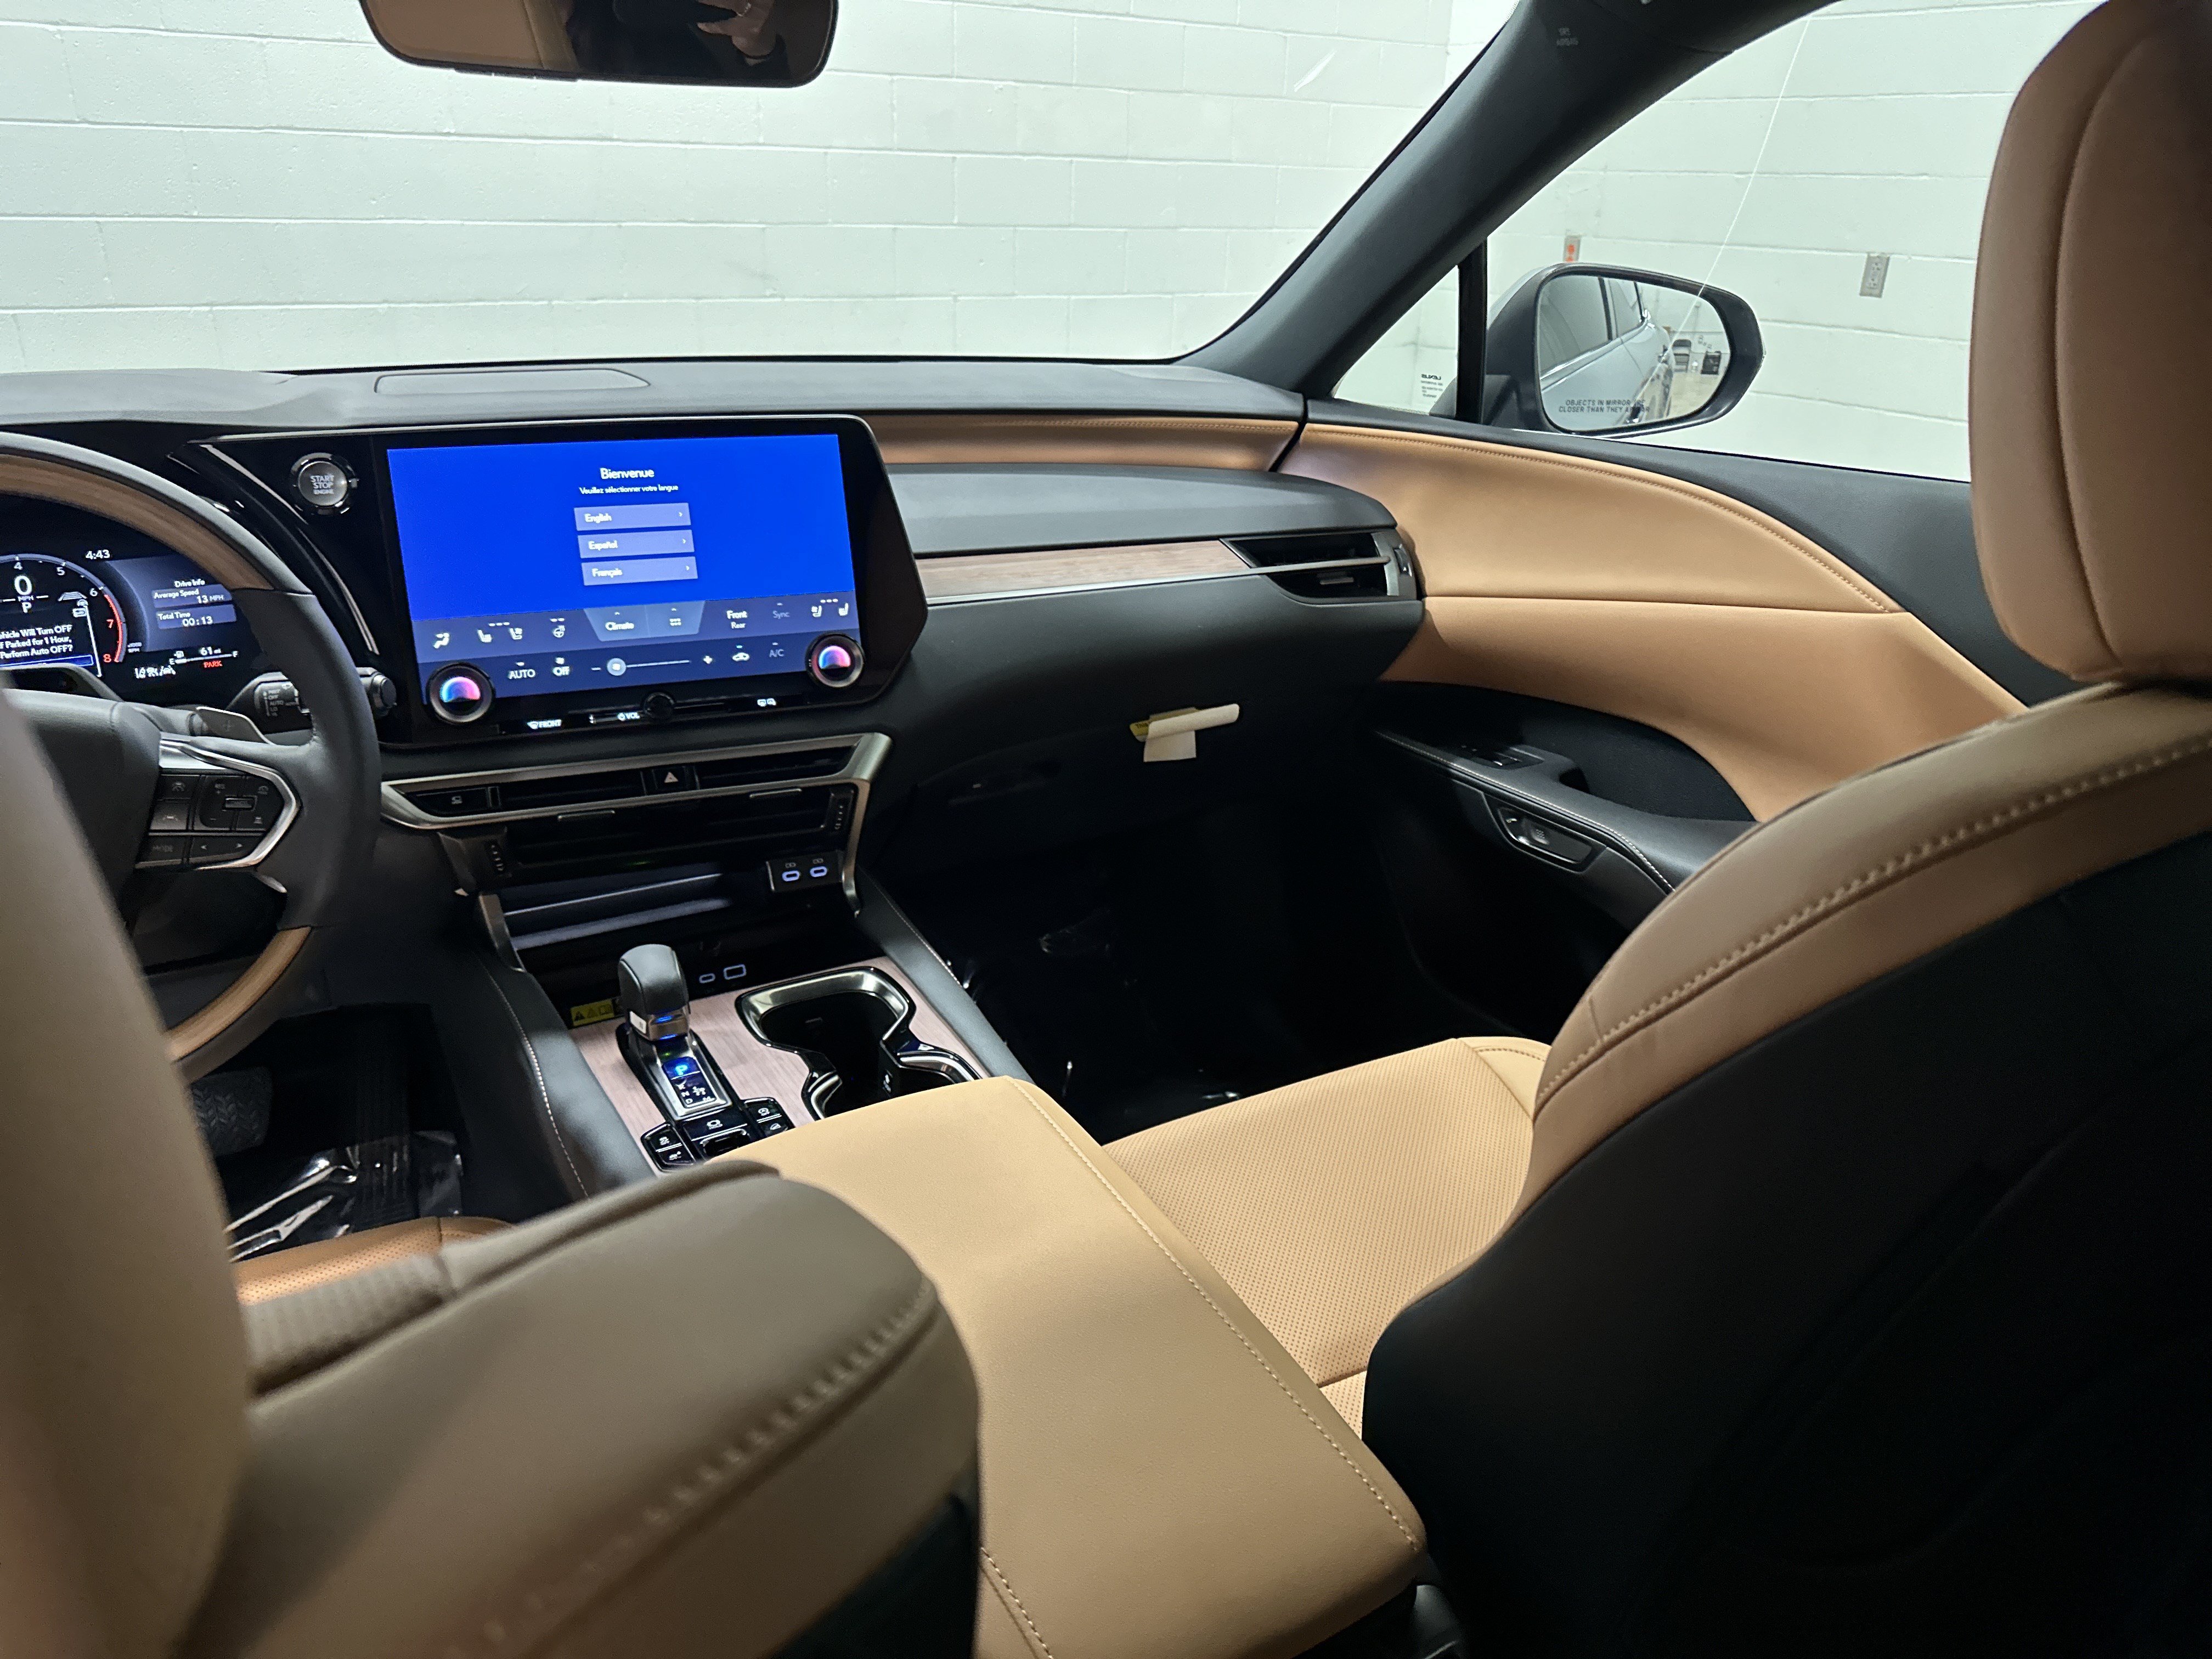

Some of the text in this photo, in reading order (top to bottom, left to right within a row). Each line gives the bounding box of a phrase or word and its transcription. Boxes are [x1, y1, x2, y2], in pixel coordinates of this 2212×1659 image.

[600, 467, 655, 479] Bienvenue
[309, 475, 335, 483] START
[658, 484, 679, 493] langue
[584, 513, 612, 524] English
[588, 540, 618, 551] Español
[85, 549, 111, 560] 4:43
[14, 562, 23, 571] 4
[57, 567, 66, 576] 5
[591, 568, 623, 578] Français
[14, 574, 33, 596] 0
[89, 588, 98, 597] 6
[154, 588, 200, 599] Average Speed
[196, 595, 208, 604] 13
[21, 601, 32, 613] P
[157, 612, 174, 620] Total
[726, 610, 748, 619] Front
[772, 610, 790, 619] Sync
[106, 619, 114, 629] 7
[605, 622, 635, 631] Climate
[731, 621, 747, 629] Rear
[0, 624, 72, 639] ehicle Will Turn OFF
[5, 639, 32, 648] Parked
[31, 637, 43, 646] for
[49, 635, 72, 644] Hour,
[0, 644, 74, 659] Perform Auto OFF?
[199, 646, 213, 656] 61
[769, 648, 785, 657] A/C
[103, 653, 112, 663] 8
[204, 660, 223, 668] PARK
[508, 669, 536, 680] AUTO
[552, 665, 571, 676] Off
[538, 719, 562, 728] FRONT
[675, 1064, 688, 1076] P
